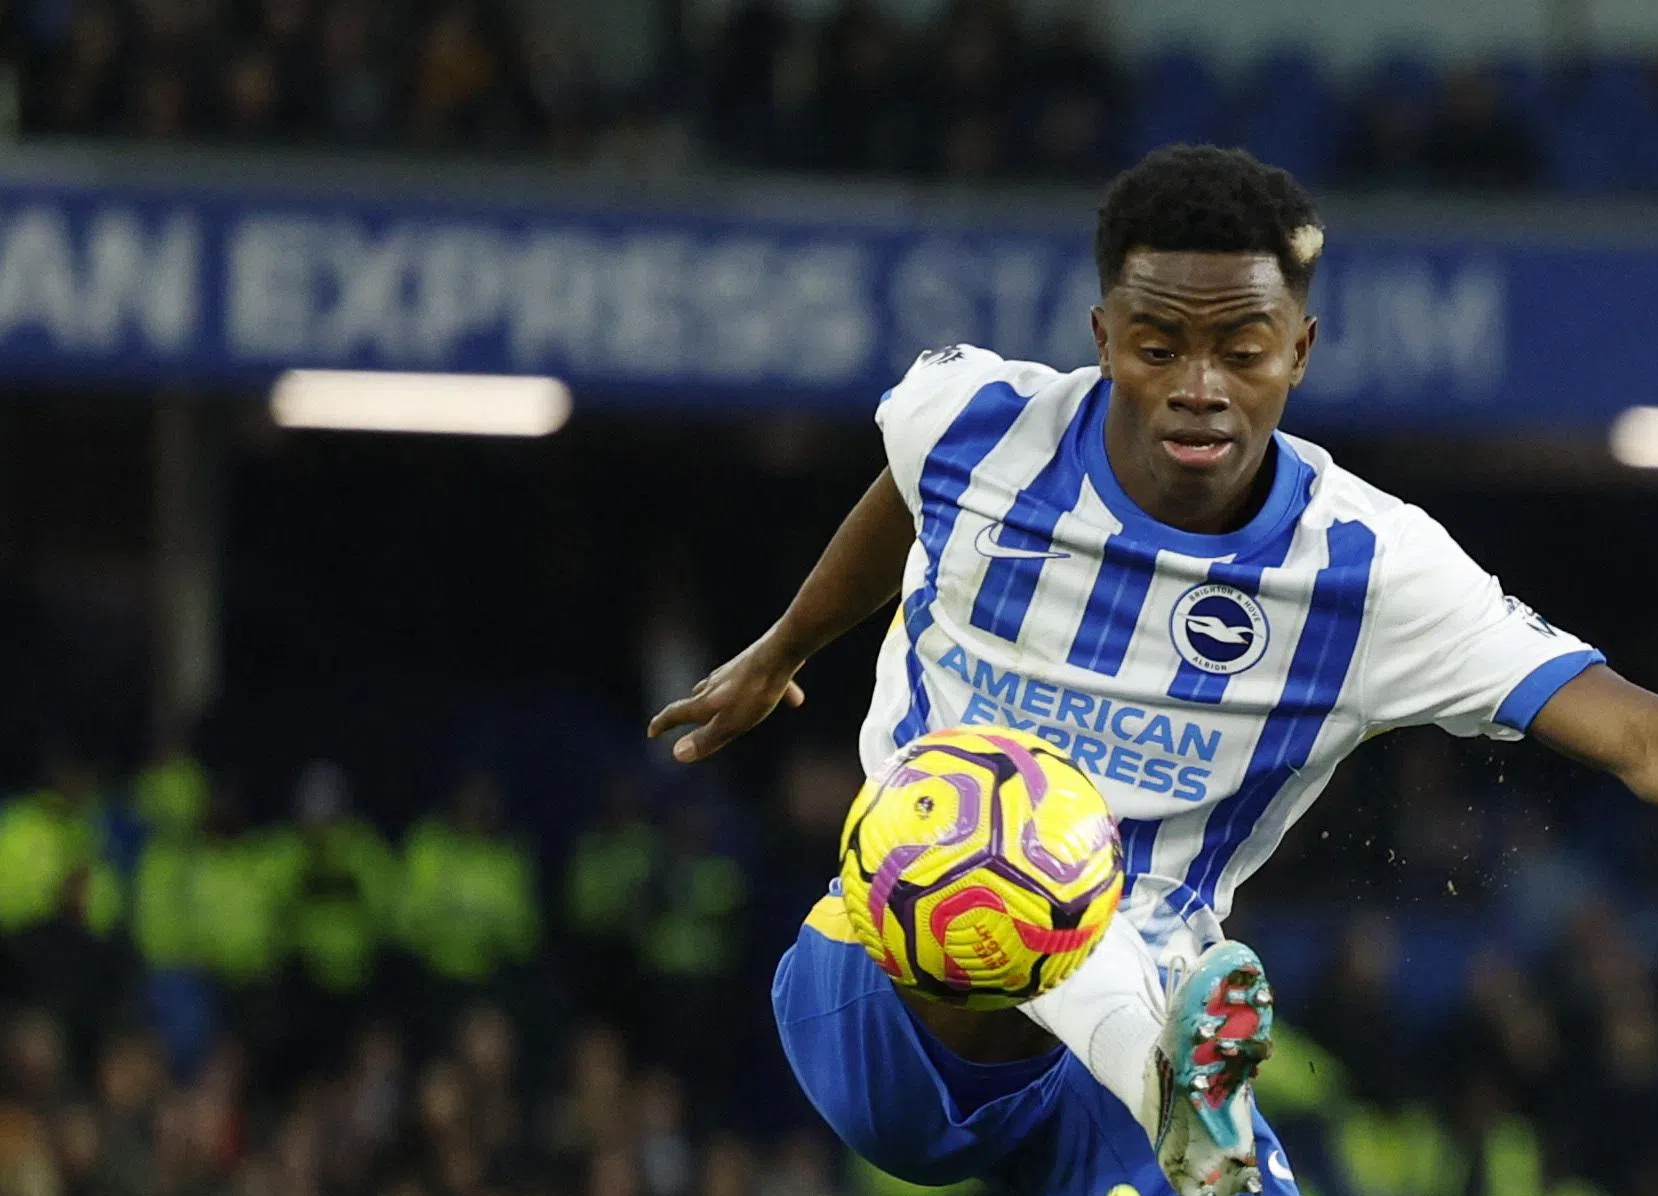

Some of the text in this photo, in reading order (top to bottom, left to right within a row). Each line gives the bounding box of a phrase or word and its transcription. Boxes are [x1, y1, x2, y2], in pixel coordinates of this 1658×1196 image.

[226, 210, 868, 385] EXPRESS
[1188, 585, 1234, 602] BRIGHTON
[1243, 600, 1262, 622] HOVE
[1192, 655, 1228, 671] ALBION
[937, 643, 1223, 763] AMERICAN
